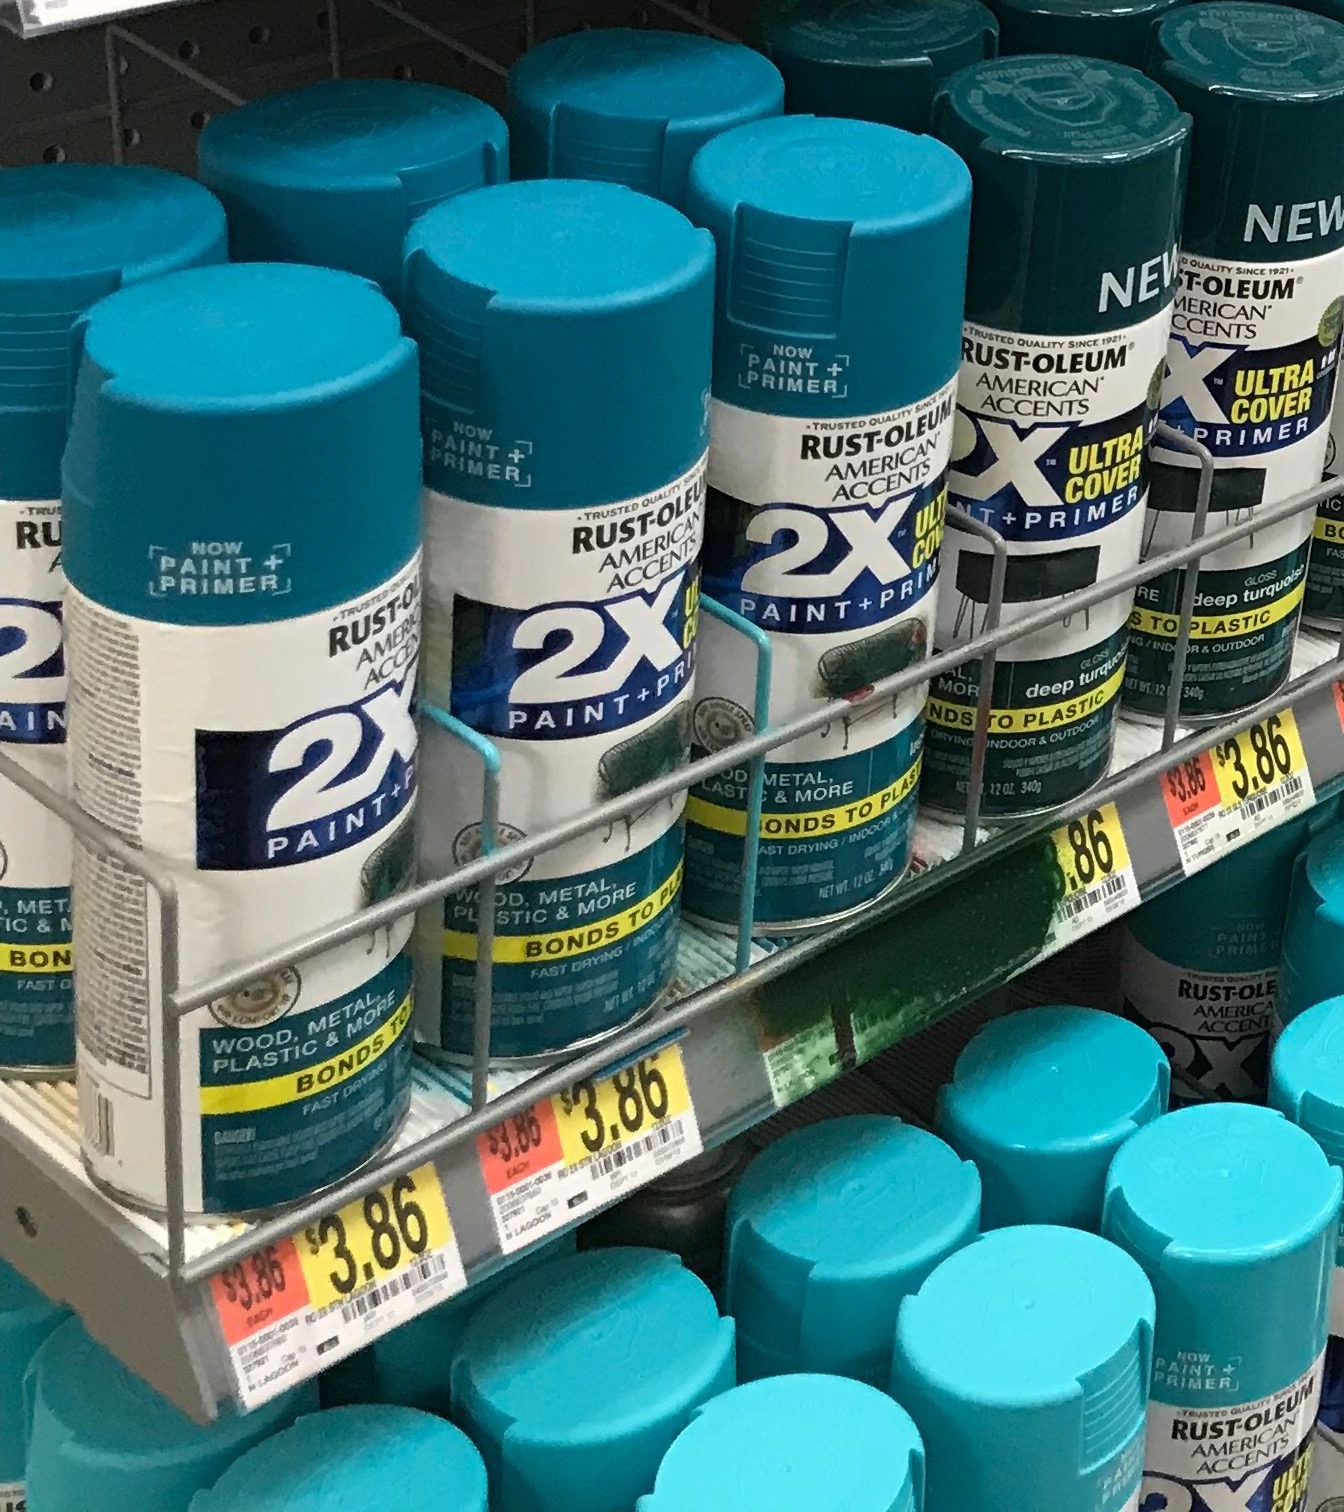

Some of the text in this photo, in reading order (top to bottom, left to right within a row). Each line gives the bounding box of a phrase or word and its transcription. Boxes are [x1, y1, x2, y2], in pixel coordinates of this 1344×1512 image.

[747, 355, 818, 376] PAINT
[772, 343, 813, 360] NOW
[745, 371, 839, 395] PRIMER
[976, 375, 1099, 397] AMERICAN
[1233, 362, 1314, 397] ULTRA
[979, 394, 1090, 419] ACCENTS
[1230, 388, 1312, 424] COVER
[800, 395, 952, 461] RUST-OLEUM
[430, 447, 520, 483] PRIMER
[824, 432, 938, 483] AMERICAN
[1067, 424, 1144, 473] ULTRA
[831, 457, 932, 503] ACCENTS
[1063, 458, 1142, 504] COVER
[191, 542, 243, 555] NOW
[740, 494, 915, 600] 2X
[160, 557, 251, 574] PAINT
[1244, 570, 1277, 587] GLOSS
[161, 575, 279, 594] PRIMER
[1191, 587, 1254, 608] deep
[507, 571, 685, 704] 2X
[1189, 608, 1272, 634] PLASTIC
[1025, 678, 1073, 700] deep
[1022, 688, 1104, 728] PLASTIC
[537, 879, 618, 909] METAL,
[577, 882, 637, 918] MORE
[525, 901, 654, 959] BONDS TO
[212, 993, 384, 1057] WOOD, METAL,
[212, 992, 397, 1075] PLASTIC MORE
[295, 1039, 385, 1093] BONDS
[306, 1178, 430, 1296] $3.86
[1153, 1376, 1232, 1391] PRIMER
[1196, 1435, 1290, 1475] ACCENTS
